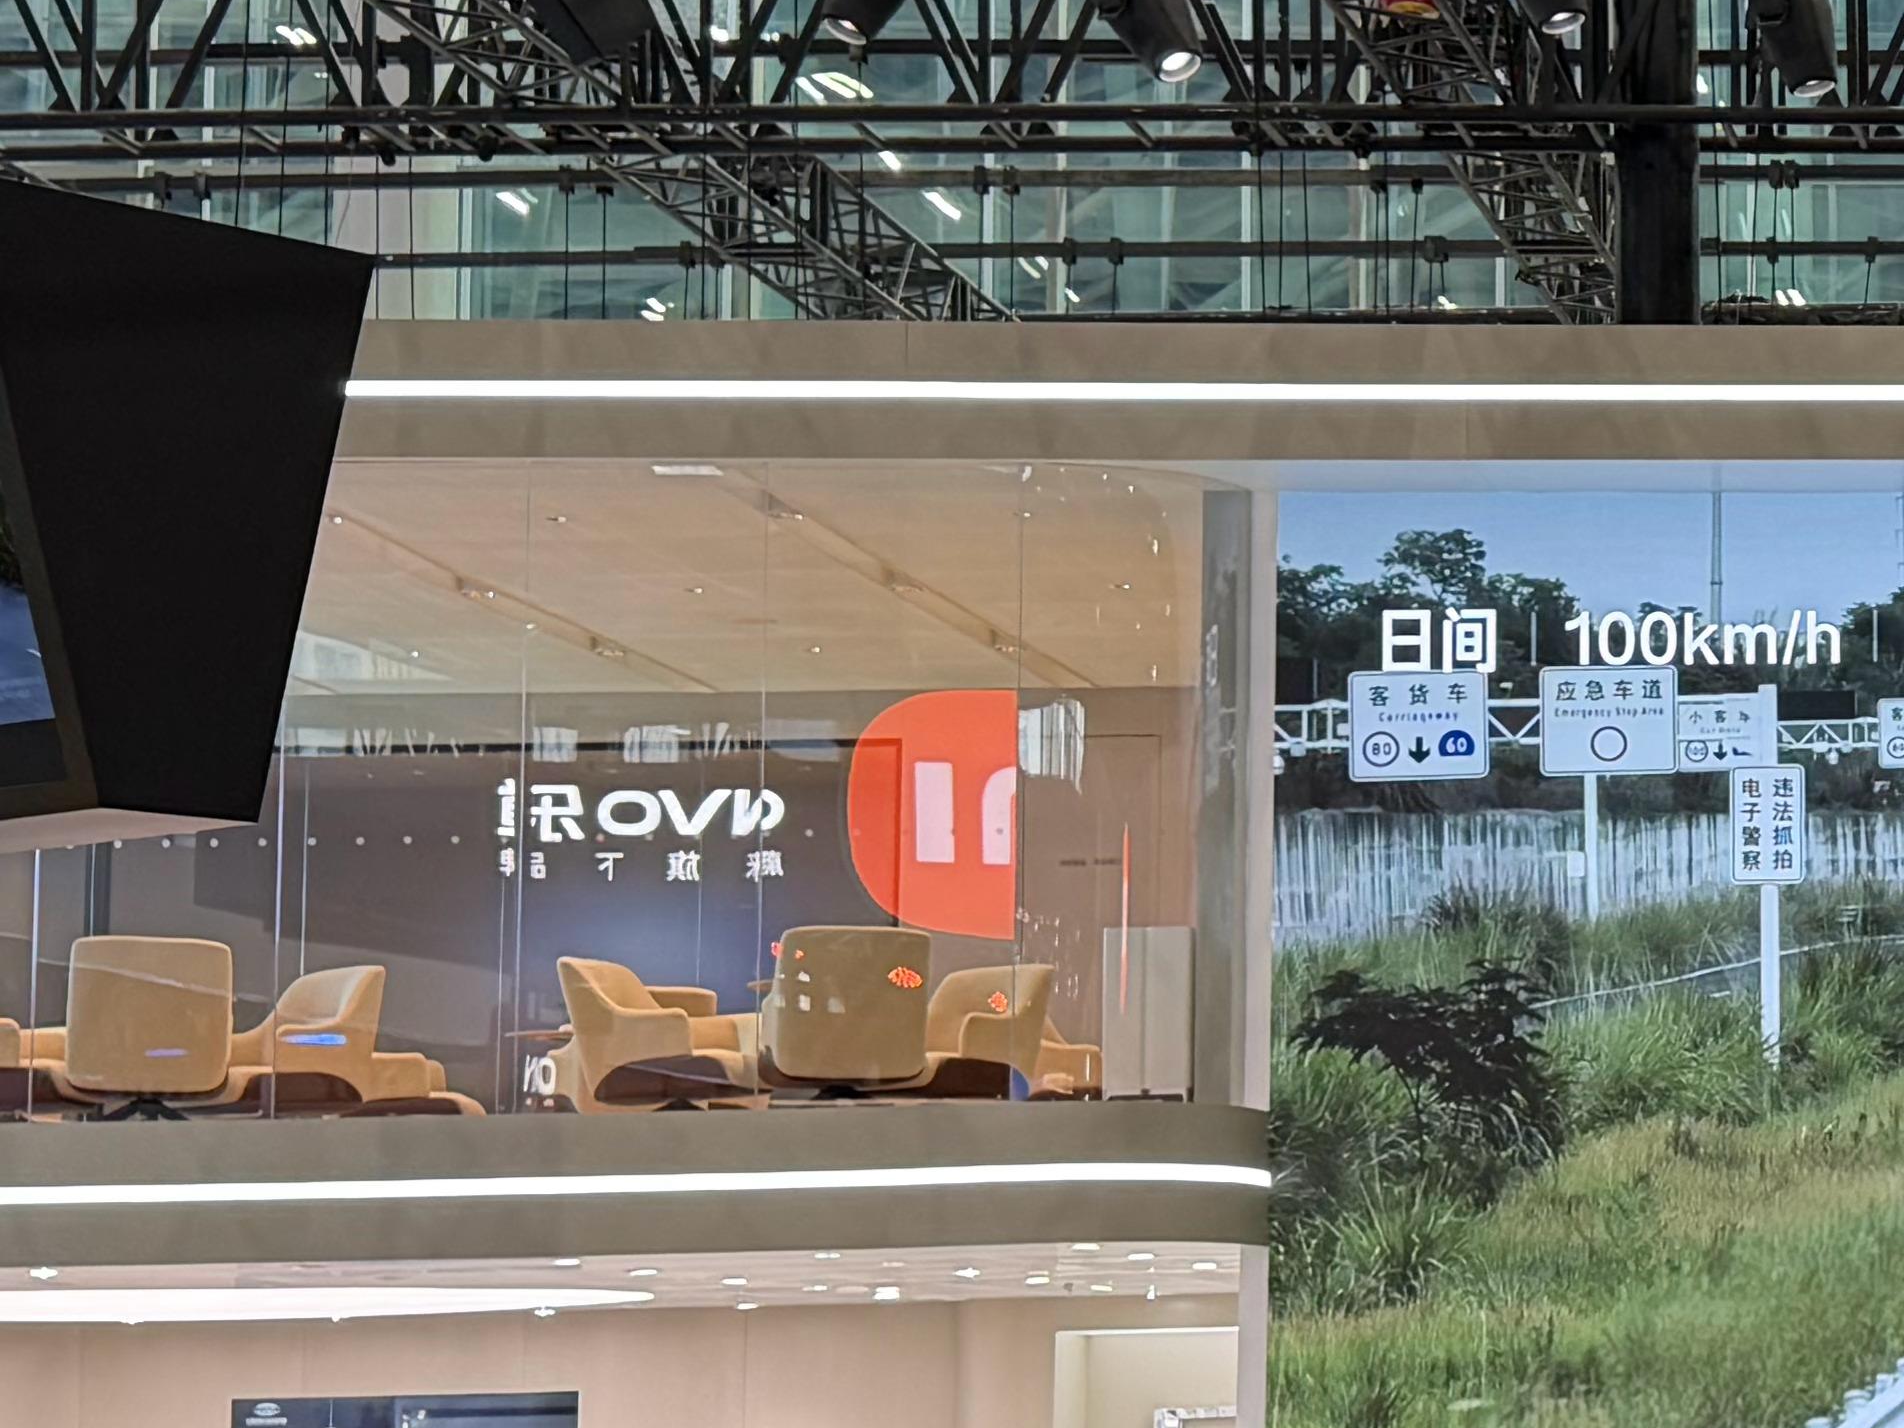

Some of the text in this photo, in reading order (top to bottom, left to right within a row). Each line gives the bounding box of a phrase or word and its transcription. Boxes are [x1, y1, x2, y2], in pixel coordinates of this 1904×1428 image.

[1382, 607, 1497, 673] 日间
[1564, 609, 1841, 666] 100km/h
[1369, 682, 1469, 707] 客货车
[1556, 679, 1664, 702] 应急车道
[1371, 741, 1393, 758] 80
[1446, 736, 1467, 754] 60
[1742, 778, 1762, 871] 电子警察
[1772, 778, 1794, 870] 违法抓拍
